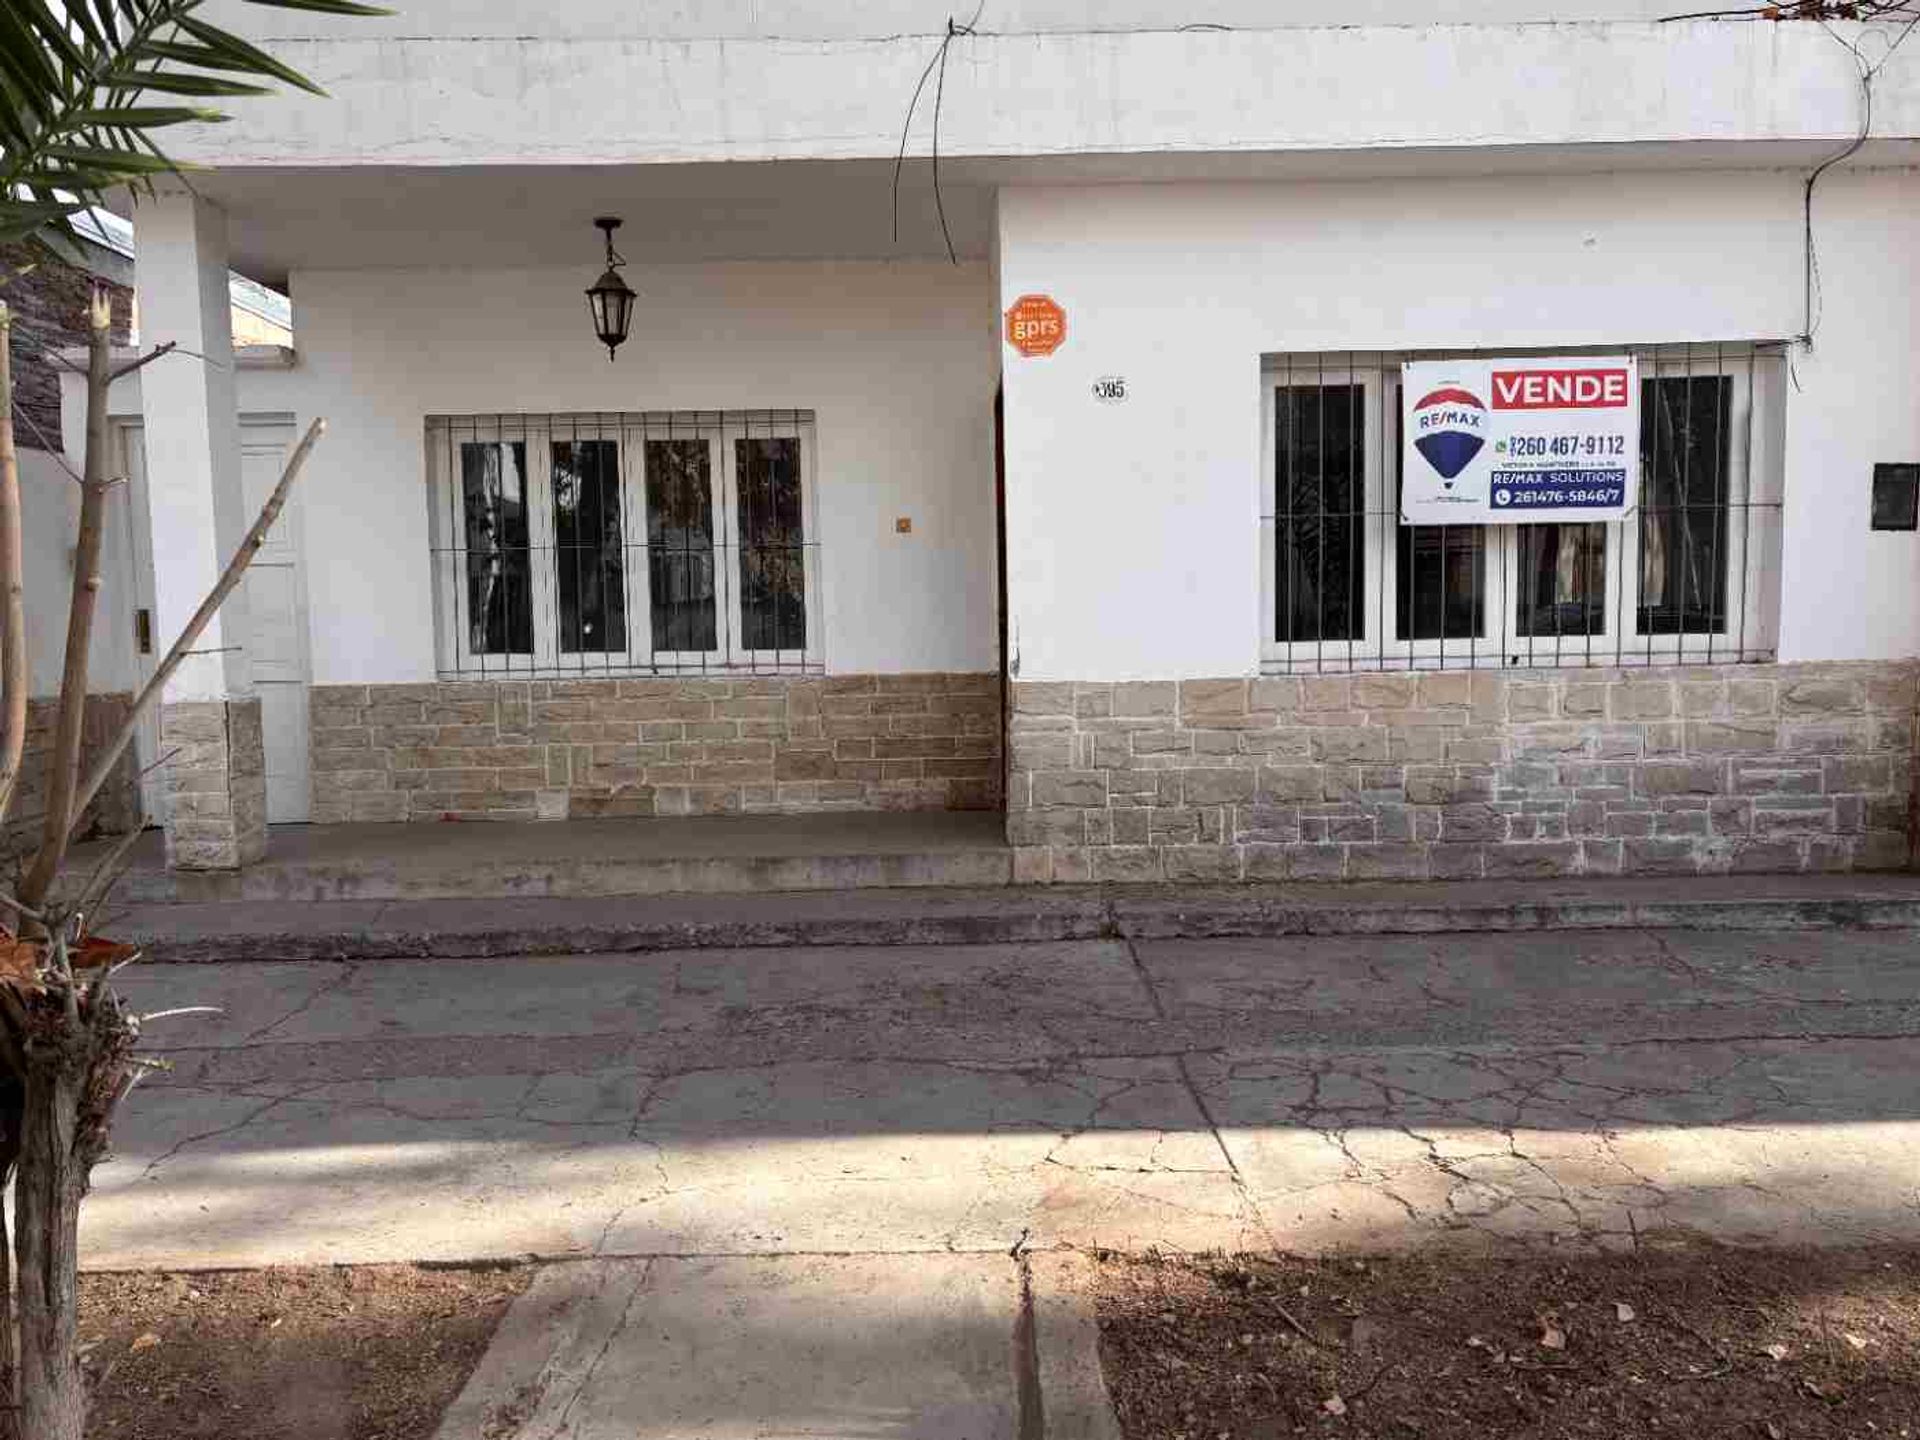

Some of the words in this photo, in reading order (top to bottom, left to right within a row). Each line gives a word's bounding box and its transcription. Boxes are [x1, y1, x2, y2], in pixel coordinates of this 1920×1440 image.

[1015, 320, 1059, 340] gprs
[1495, 375, 1625, 403] VENDE
[1419, 411, 1481, 429] RE/MAX
[1517, 436, 1546, 456] 260
[1549, 435, 1624, 455] 467-9112
[1493, 472, 1543, 484] RE/MAX
[1549, 471, 1624, 483] SOLUTIONS
